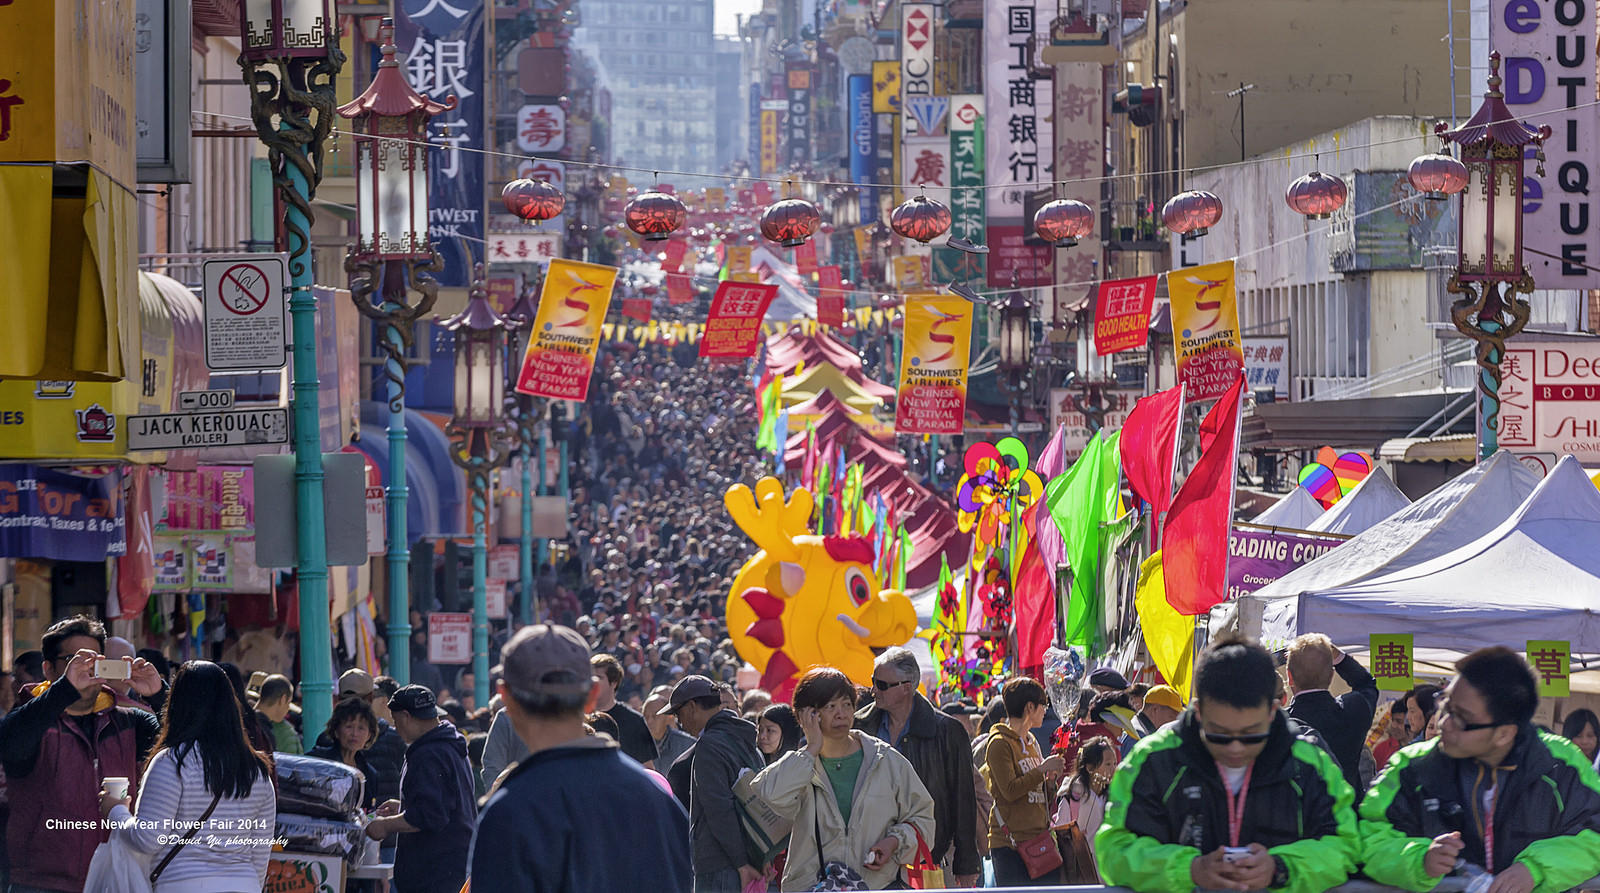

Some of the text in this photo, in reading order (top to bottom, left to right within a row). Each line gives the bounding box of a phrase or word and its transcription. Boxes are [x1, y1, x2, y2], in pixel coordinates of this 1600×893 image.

[856, 91, 872, 156] citibank
[1098, 314, 1148, 338] GOOD HEALTH
[538, 331, 594, 345] SOUTHWEST
[1181, 330, 1235, 348] SOUTHWEST
[535, 341, 592, 354] AIRLINES
[1182, 340, 1234, 357] AIRLINES
[907, 368, 964, 377] SOUTHWEST
[525, 379, 581, 397] & PARADE
[906, 378, 961, 387] AIRLINES
[199, 392, 229, 407] 000
[1186, 387, 1196, 398] &
[1500, 354, 1529, 442] 美之屋
[0, 411, 24, 425] ES
[139, 413, 272, 436] JACK KEROUAC
[902, 418, 957, 429] & PARADE
[1056, 414, 1084, 427] GOLDE
[16, 479, 38, 491] LTE
[49, 516, 85, 531] Taxes
[87, 518, 98, 532] &
[1293, 542, 1335, 563] COM
[1243, 573, 1277, 585] Groceri
[1373, 641, 1411, 679] 蟲
[1531, 648, 1567, 686] 草
